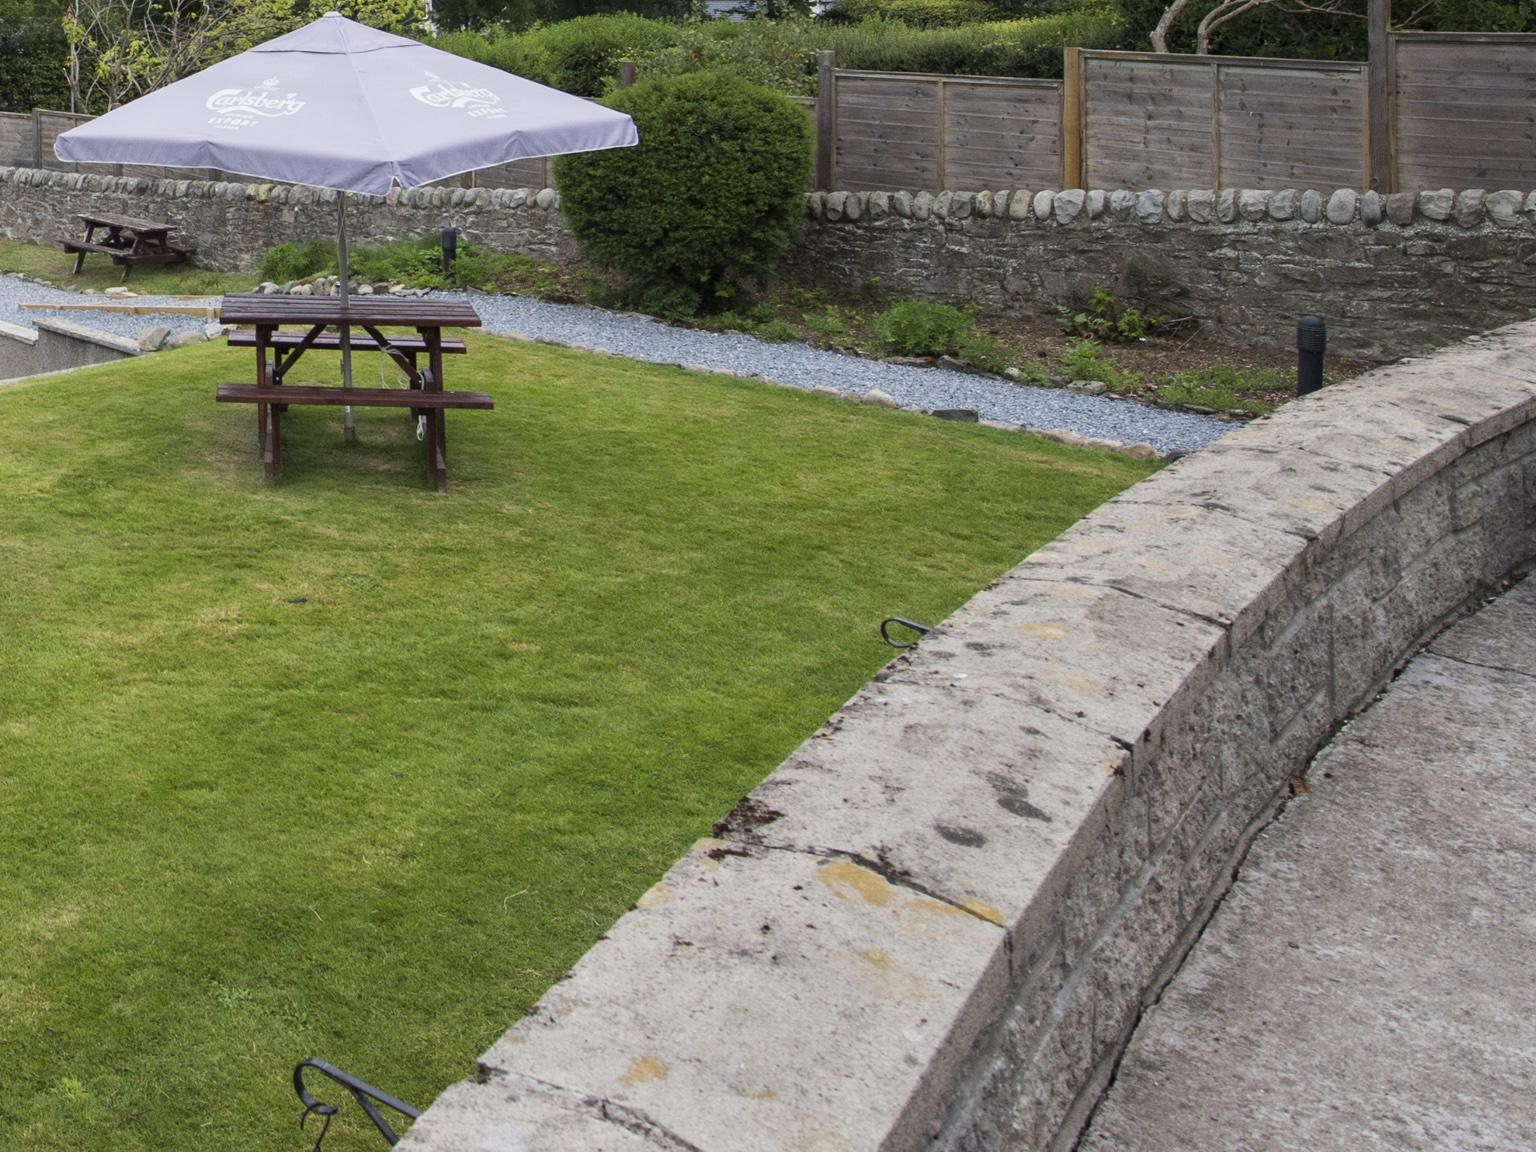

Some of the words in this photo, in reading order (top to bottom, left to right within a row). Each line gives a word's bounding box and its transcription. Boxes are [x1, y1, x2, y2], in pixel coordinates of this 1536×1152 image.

[206, 89, 307, 117] Carlsberg
[409, 81, 500, 108] Carlsberg
[207, 117, 259, 127] EXPORT
